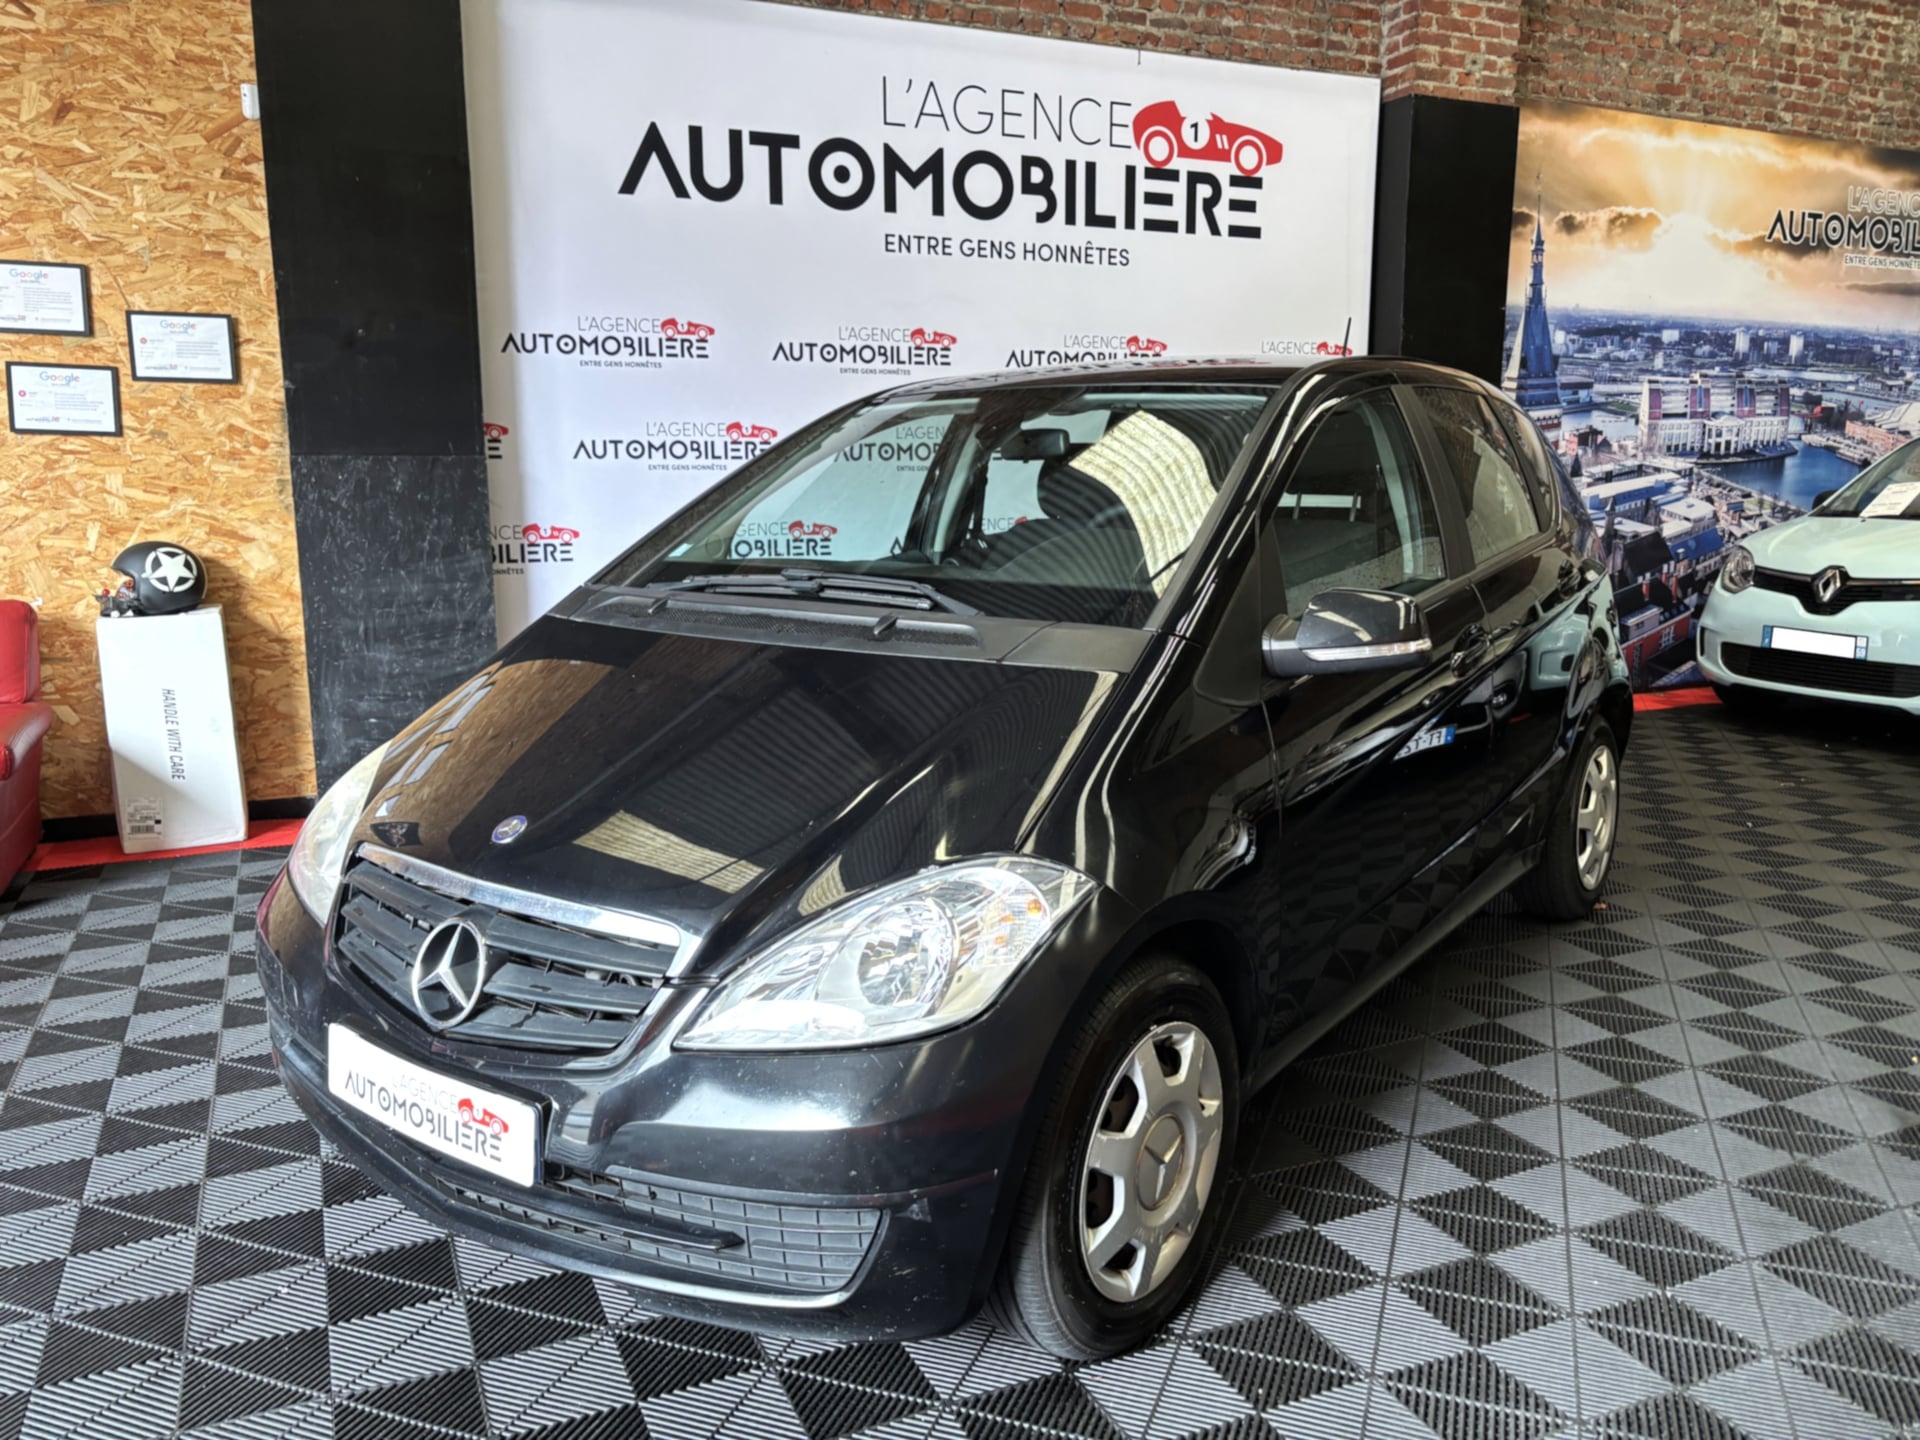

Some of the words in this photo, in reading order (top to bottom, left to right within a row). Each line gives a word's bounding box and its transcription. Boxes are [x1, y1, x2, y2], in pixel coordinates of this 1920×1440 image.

[882, 75, 1132, 149] L'AGENCE
[1189, 121, 1199, 143] 1
[617, 120, 1263, 240] AUTOMOBILIERE
[884, 233, 953, 256] ENTRE
[959, 238, 1017, 260] GENS
[1023, 240, 1131, 267] HONNÊTES
[1844, 254, 1867, 266] ENTRE
[1868, 256, 1887, 267] GENS
[9, 267, 49, 281] Google
[159, 319, 198, 332] Google
[577, 316, 661, 334] L'AGENCE
[838, 326, 910, 343] L'AGENCE
[500, 332, 710, 359] AUTOMOBILIERE
[1063, 334, 1126, 350] L'AGENCE
[1261, 341, 1318, 355] L'AGENCE
[772, 342, 951, 366] AUTOMOBILIERE
[579, 360, 602, 368] ENTRE
[604, 360, 624, 368] GENS
[840, 367, 859, 375] ENTRE
[39, 370, 81, 384] Google
[645, 421, 726, 438] L'AGENCE
[730, 538, 832, 558] OBILIERE
[162, 688, 179, 726] HANDLE
[166, 728, 183, 753] WITH
[169, 754, 186, 781] CARE
[344, 1069, 502, 1162] AUTOMOBILIERE
